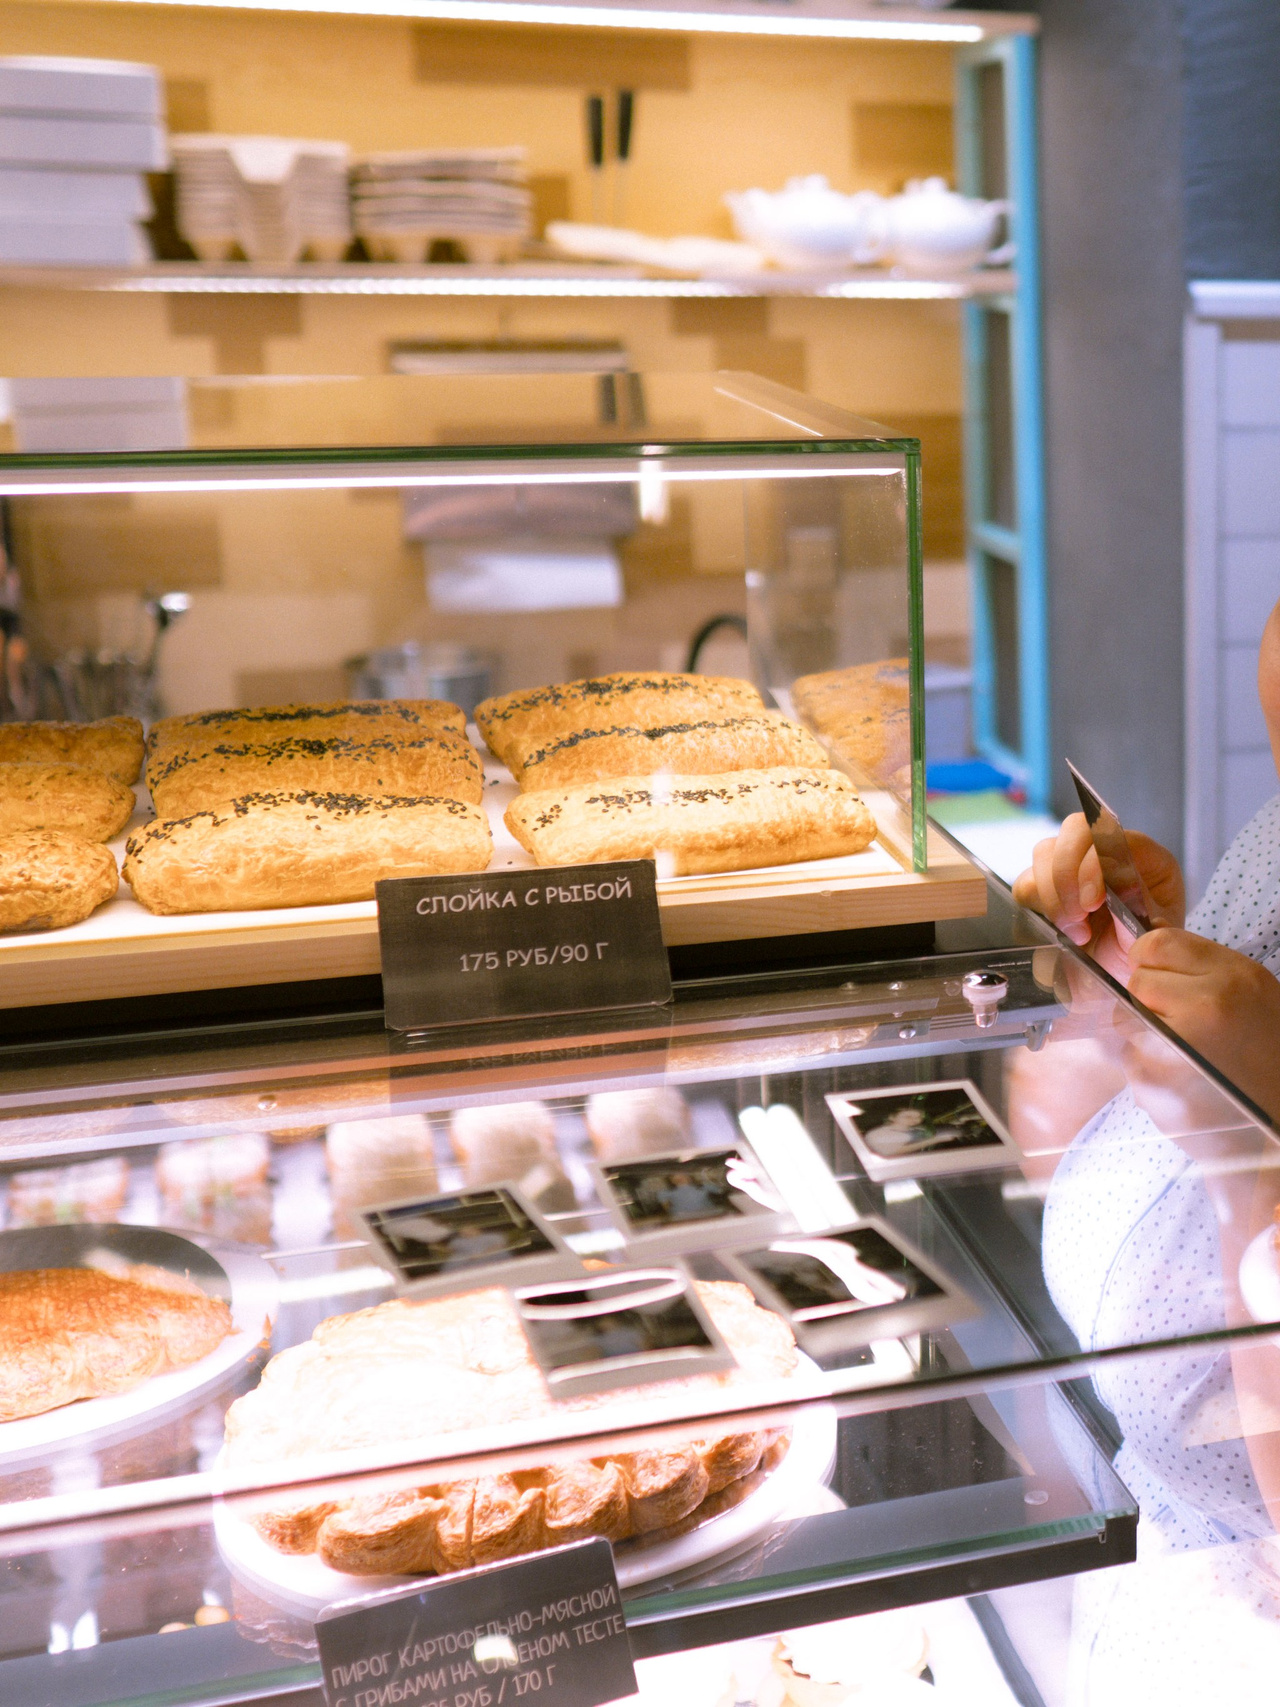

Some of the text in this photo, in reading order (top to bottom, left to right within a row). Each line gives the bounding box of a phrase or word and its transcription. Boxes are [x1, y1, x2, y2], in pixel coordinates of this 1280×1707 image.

[416, 877, 632, 915] СЛОЙКА С РЫБОЙ
[459, 943, 609, 972] 175 РУБ/90 Г
[331, 1584, 617, 1689] ПИРОГ КАРТОФЕЛЬНО-МЯСНОЙ
[354, 1668, 446, 1707] ГРИБАМИ
[450, 1660, 477, 1685] НА
[572, 1613, 625, 1646] ТЕСТЕ
[455, 1686, 492, 1707] РУБ
[511, 1670, 541, 1697] 170
[546, 1665, 557, 1686] Г
